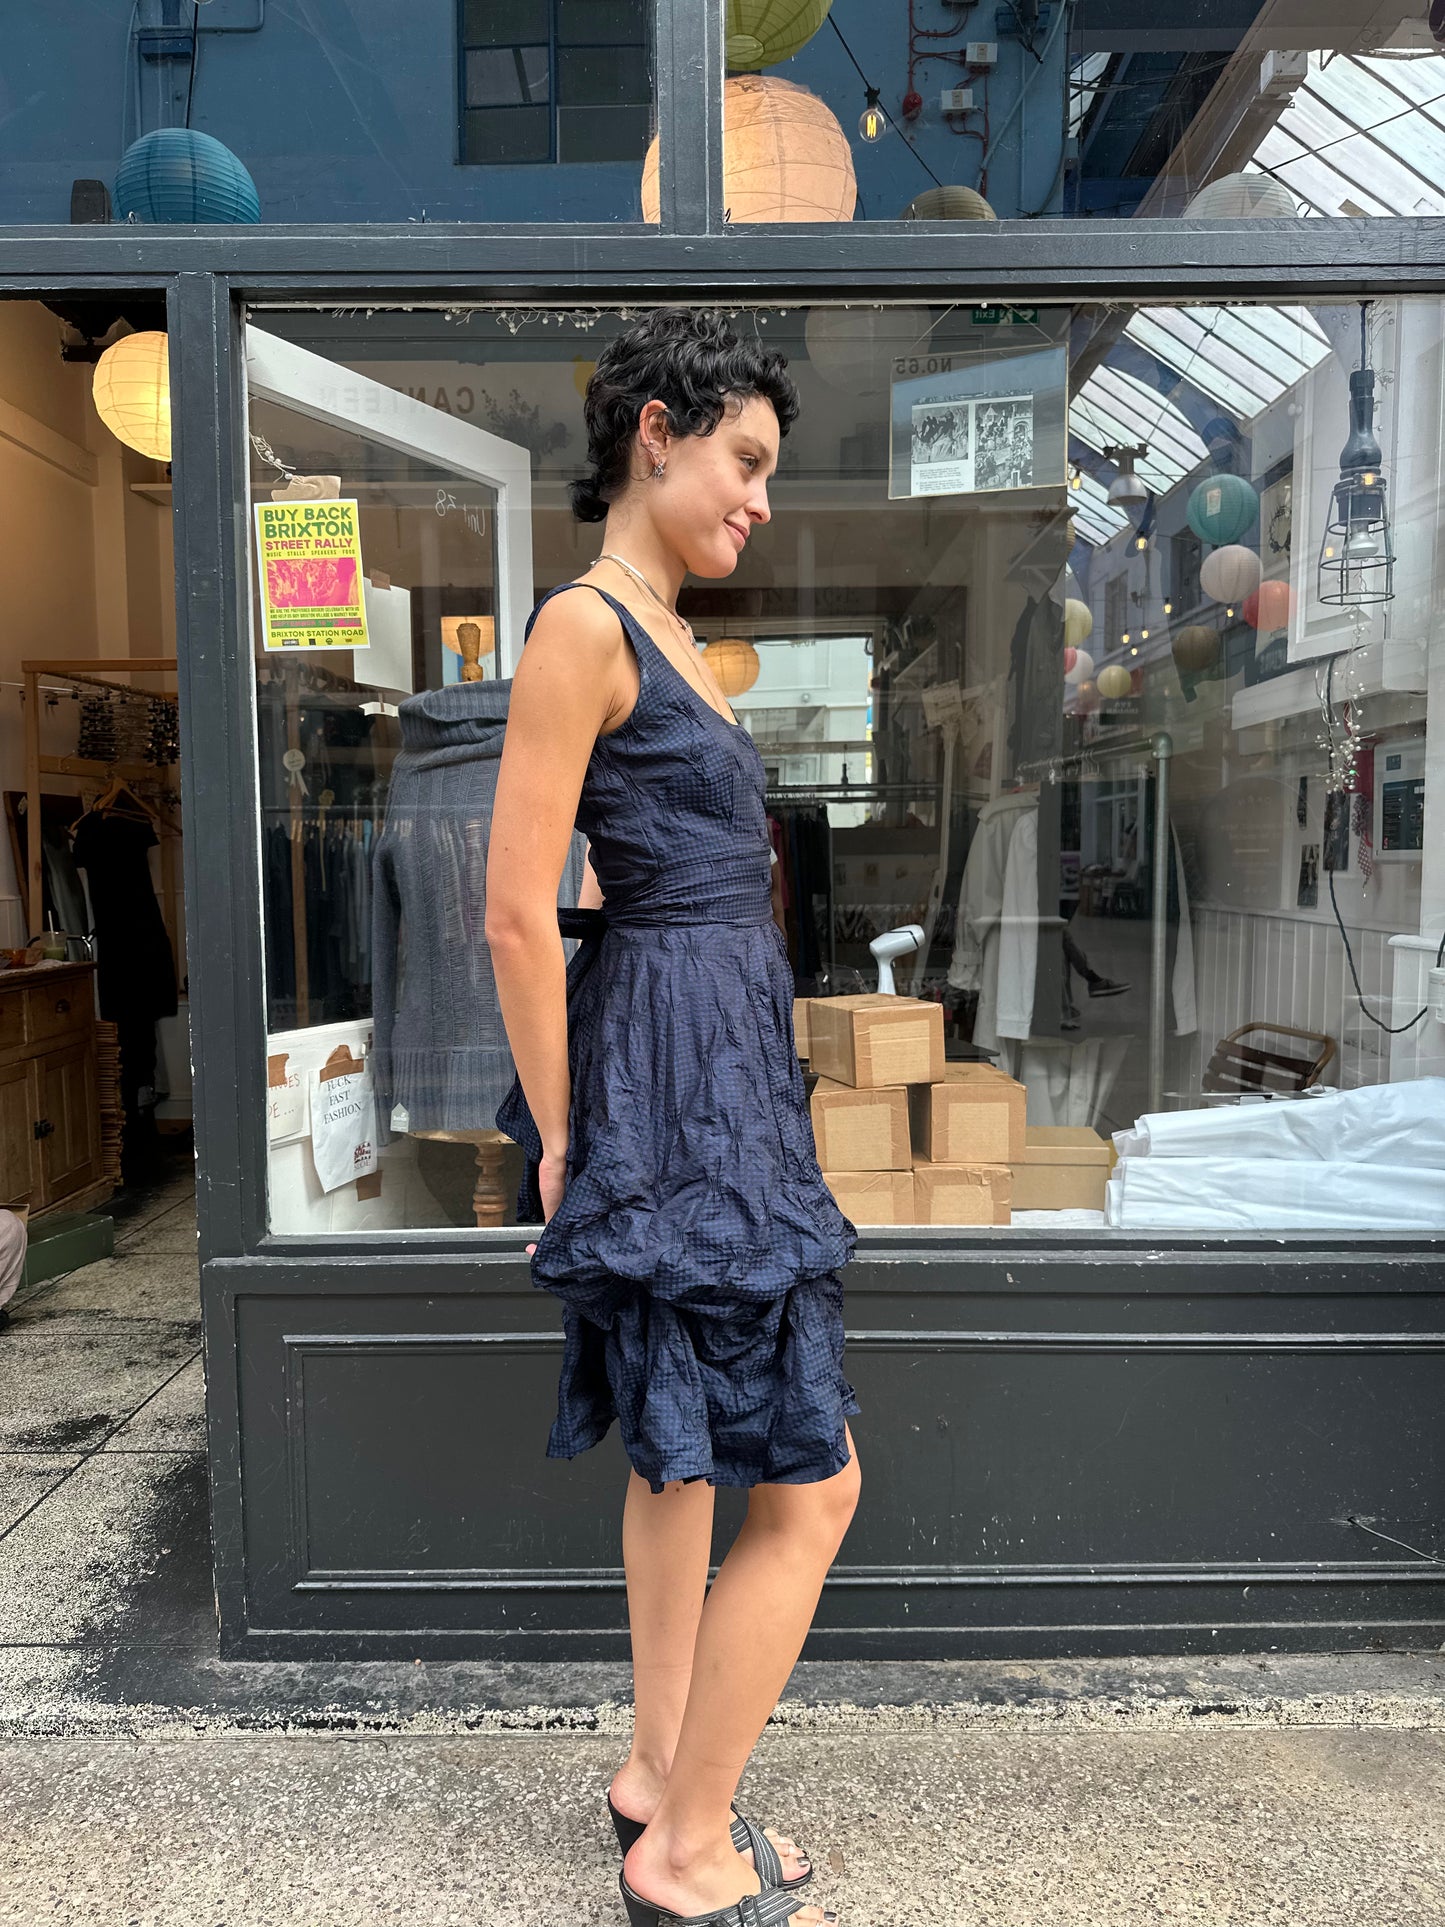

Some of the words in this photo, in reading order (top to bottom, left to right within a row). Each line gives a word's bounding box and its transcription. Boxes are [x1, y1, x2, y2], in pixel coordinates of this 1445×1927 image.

[264, 509, 298, 522] BUY
[304, 507, 352, 521] BACK
[265, 521, 354, 538] BRIXTON
[265, 540, 311, 551] STREET
[315, 538, 353, 549] RALLY
[329, 1090, 351, 1107] FAST
[324, 1101, 362, 1125] FASHION
